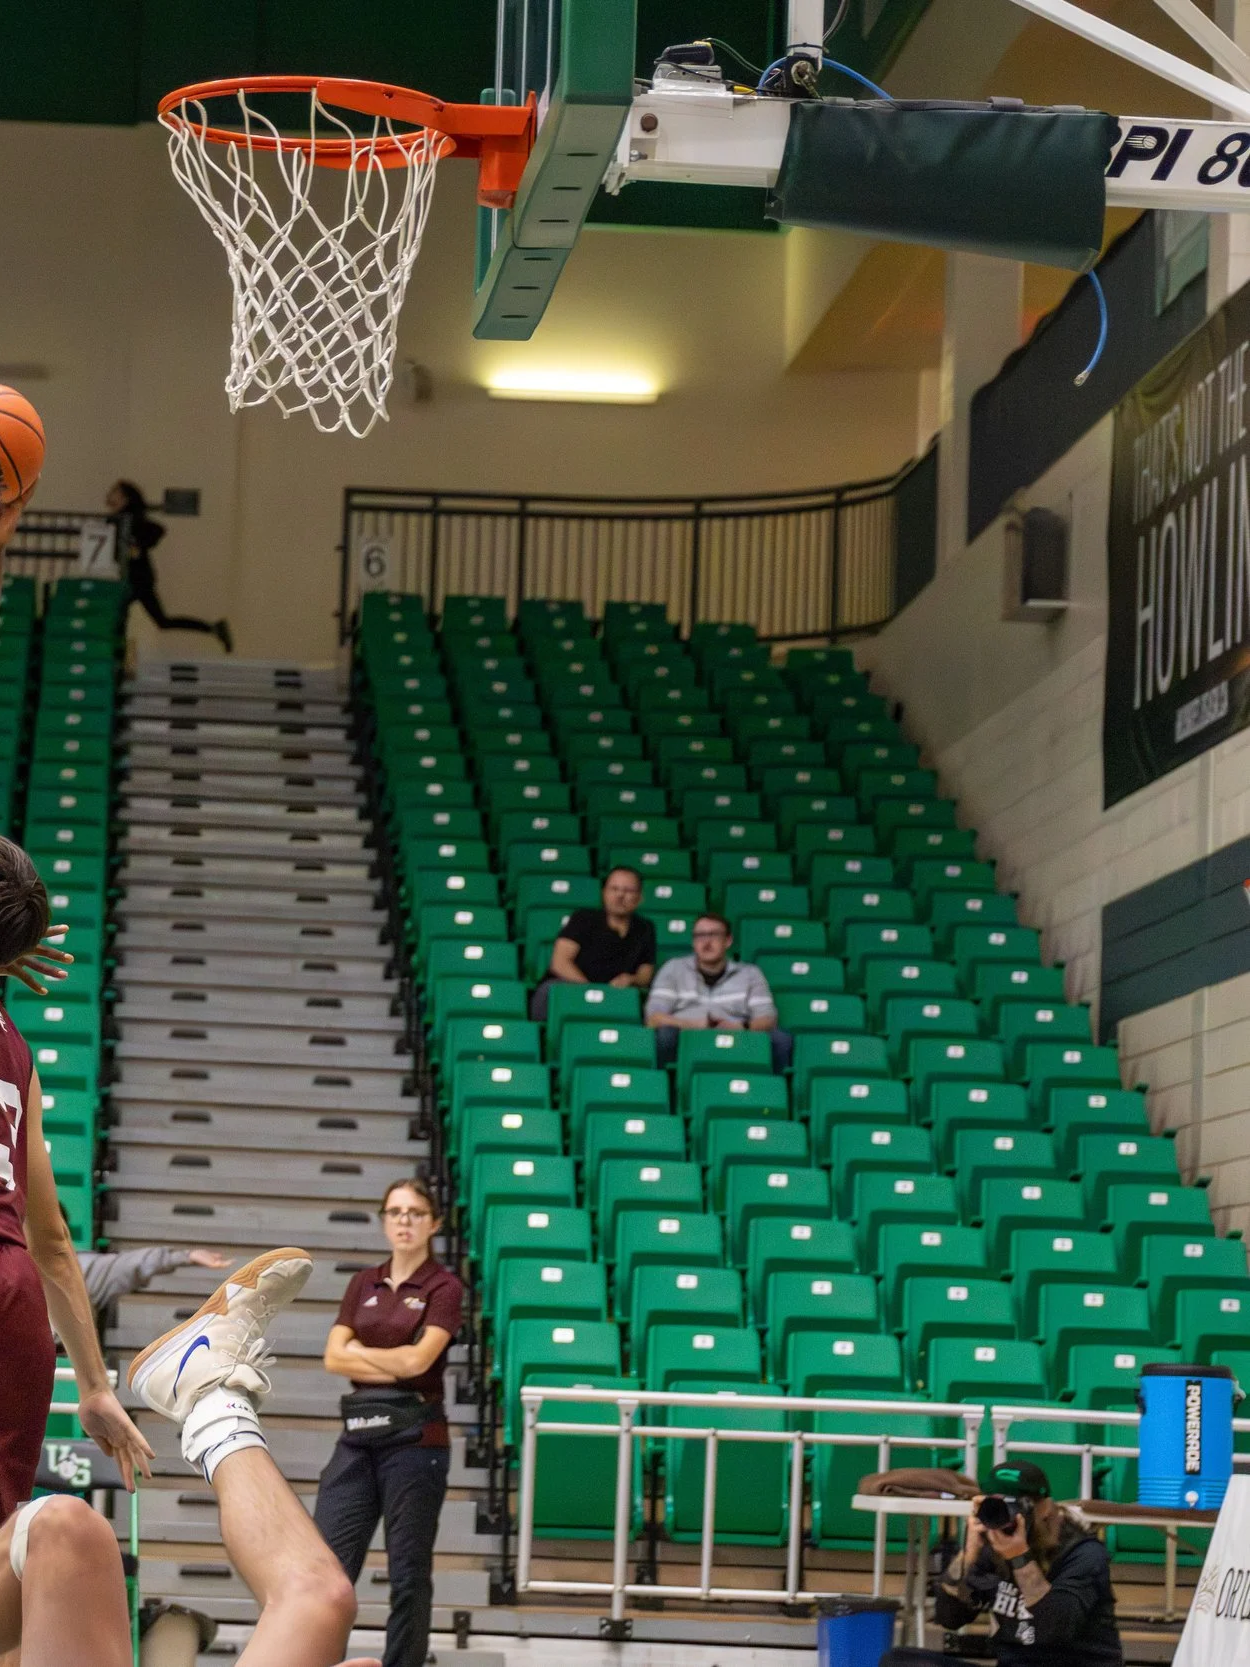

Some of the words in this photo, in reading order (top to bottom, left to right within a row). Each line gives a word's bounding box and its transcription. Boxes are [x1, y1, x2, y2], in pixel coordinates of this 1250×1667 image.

[1182, 371, 1216, 487] NOT
[1217, 341, 1249, 455] THE
[88, 534, 108, 576] 7
[363, 546, 386, 577] 6
[1186, 1384, 1201, 1473] POWERADE
